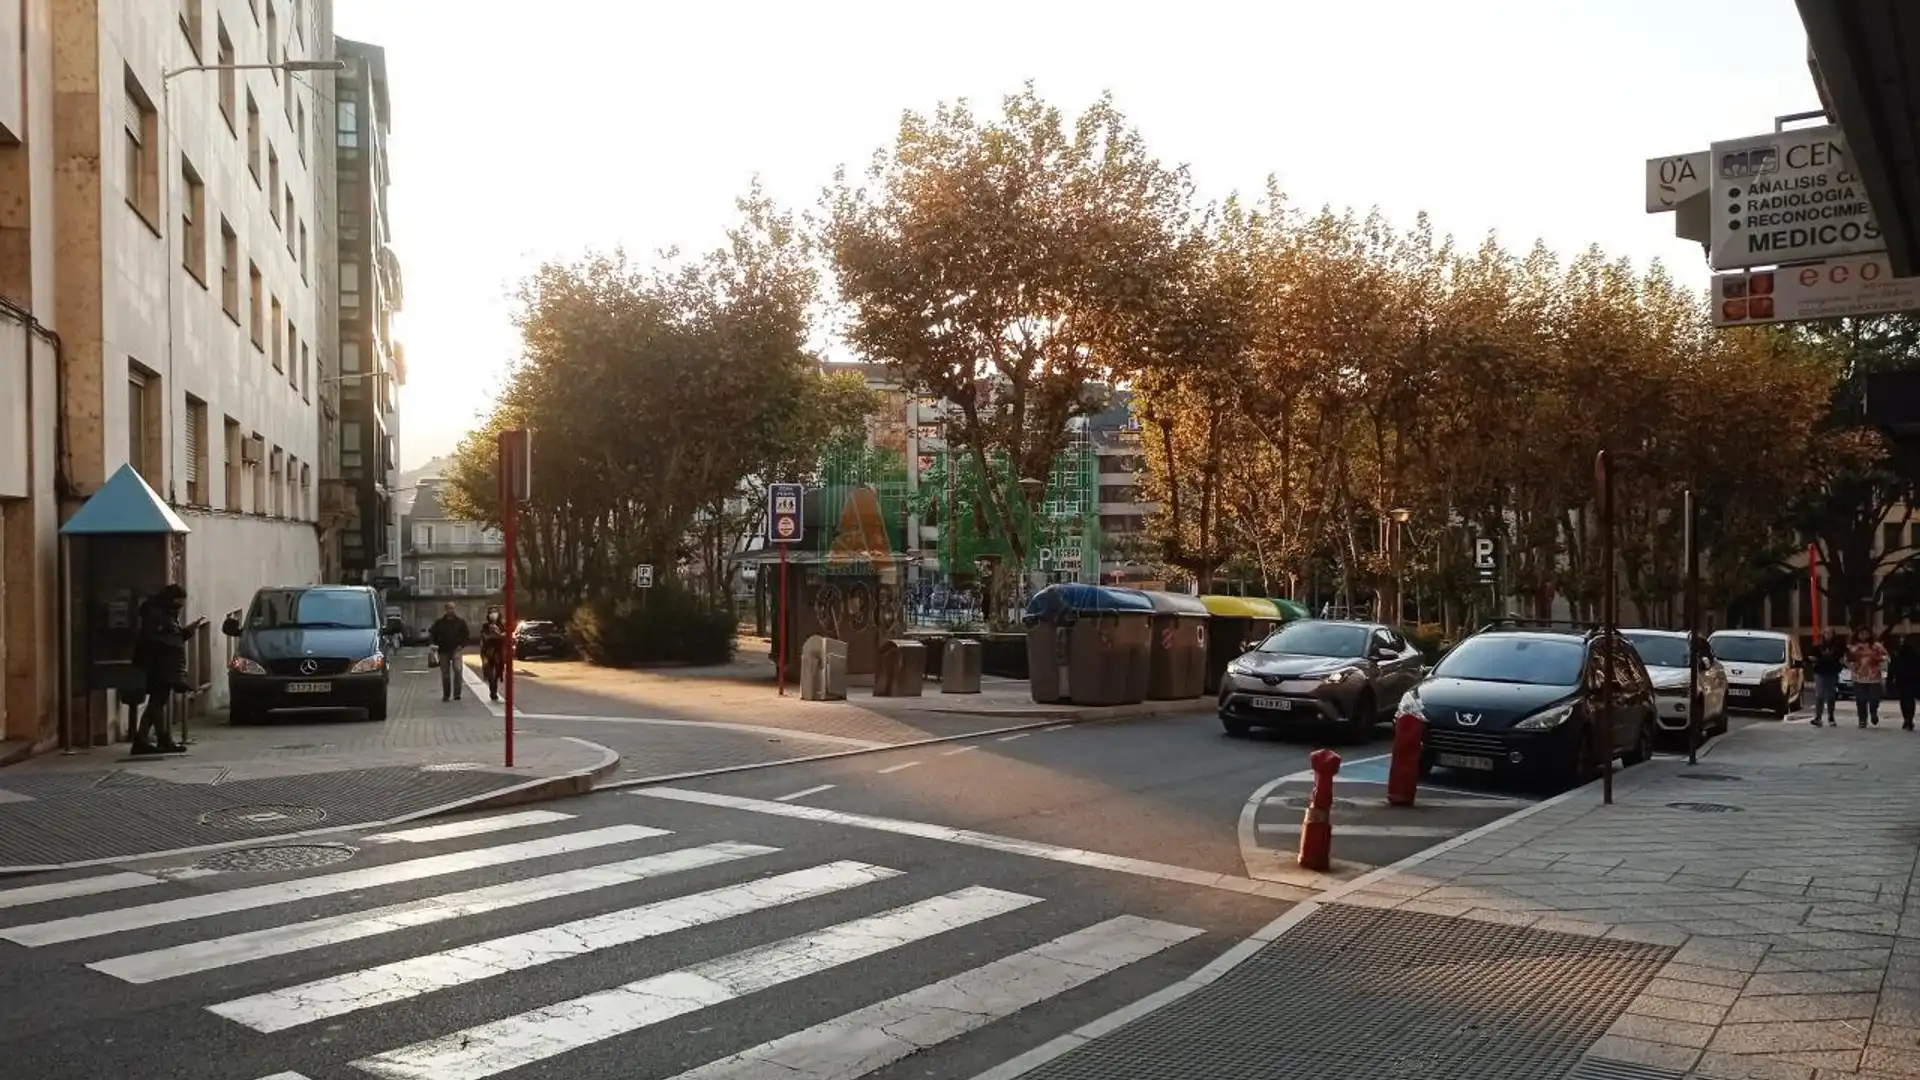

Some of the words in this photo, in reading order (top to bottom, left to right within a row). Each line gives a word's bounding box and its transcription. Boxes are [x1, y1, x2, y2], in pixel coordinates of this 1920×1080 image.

[1748, 174, 1828, 196] ANALISIS
[1748, 187, 1855, 212] RADIOLOGIA
[1748, 202, 1869, 228] RECONOCIMIE
[1749, 222, 1881, 253] MEDICOS
